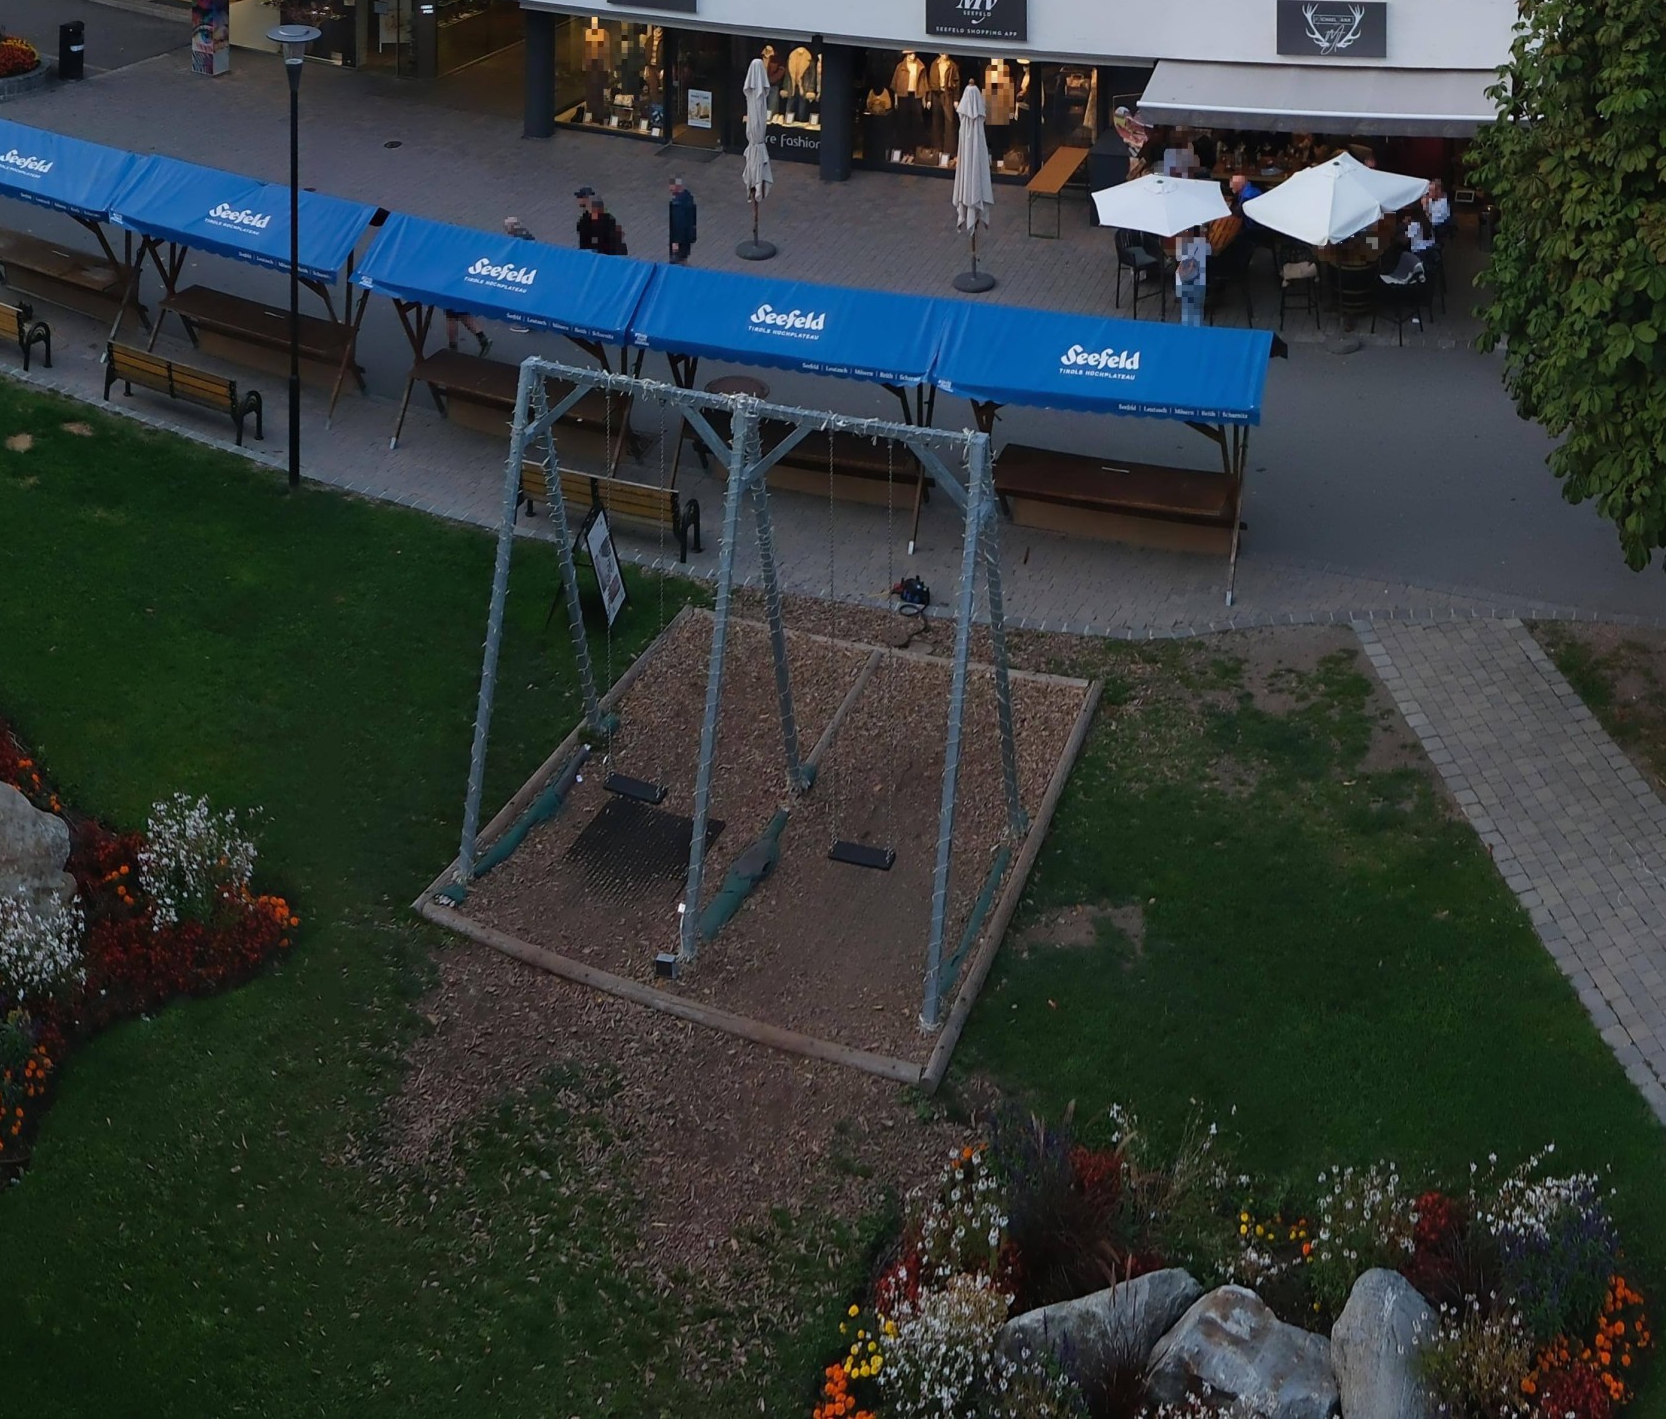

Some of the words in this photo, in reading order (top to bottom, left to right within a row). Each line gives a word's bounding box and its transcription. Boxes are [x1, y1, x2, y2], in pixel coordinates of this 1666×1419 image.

[935, 26, 965, 34] SEEFELD
[967, 28, 1002, 36] SHOPPING
[0, 149, 54, 173] Seefeld
[209, 202, 271, 229] Seefeld
[468, 257, 537, 285] Seefeld
[750, 304, 826, 331] Seefeld
[1060, 344, 1140, 370] Seefeld
